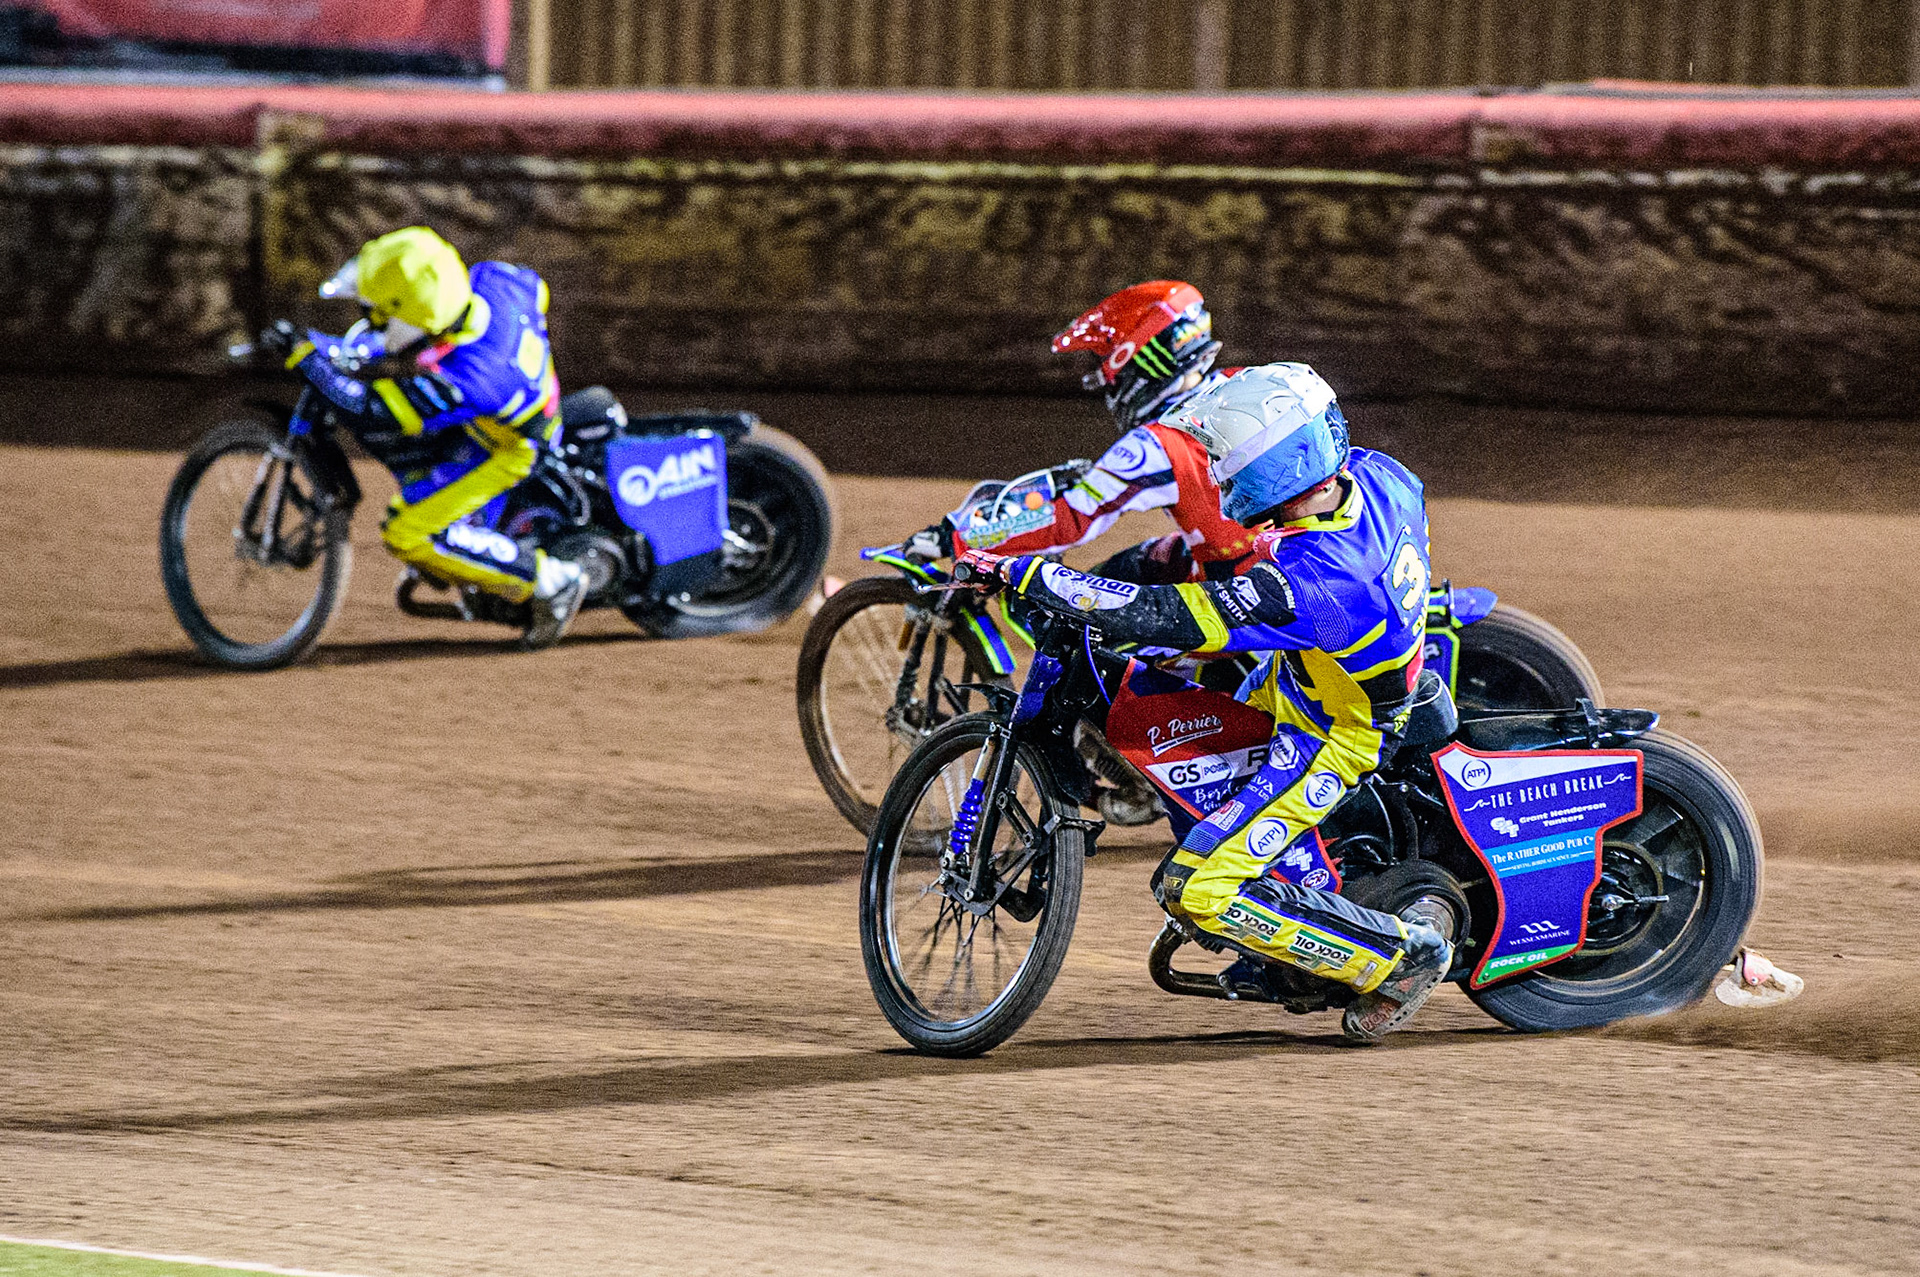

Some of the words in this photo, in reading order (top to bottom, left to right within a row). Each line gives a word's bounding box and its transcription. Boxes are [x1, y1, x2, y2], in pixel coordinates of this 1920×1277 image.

[1391, 542, 1426, 611] 3
[1218, 589, 1248, 622] SMITH
[1167, 713, 1221, 738] Perrier
[1168, 763, 1201, 786] GS
[1466, 766, 1487, 780] ATPI
[1314, 779, 1334, 802] ATPI
[1490, 791, 1513, 809] THE
[1519, 783, 1558, 803] BEACH
[1564, 774, 1604, 795] BREAK
[1519, 812, 1549, 824] Grant
[1550, 802, 1607, 817] Henderson
[1542, 814, 1585, 827] Tankers
[1256, 826, 1282, 852] ATPI
[1491, 854, 1507, 865] The
[1506, 846, 1541, 861] RATHER
[1540, 841, 1566, 854] GOOD
[1566, 838, 1583, 849] PUB
[1240, 914, 1279, 937] ROCK
[1294, 935, 1317, 950] OIL
[1315, 943, 1351, 963] ROCK
[1489, 955, 1526, 969] ROCK
[1526, 952, 1548, 963] OIL
